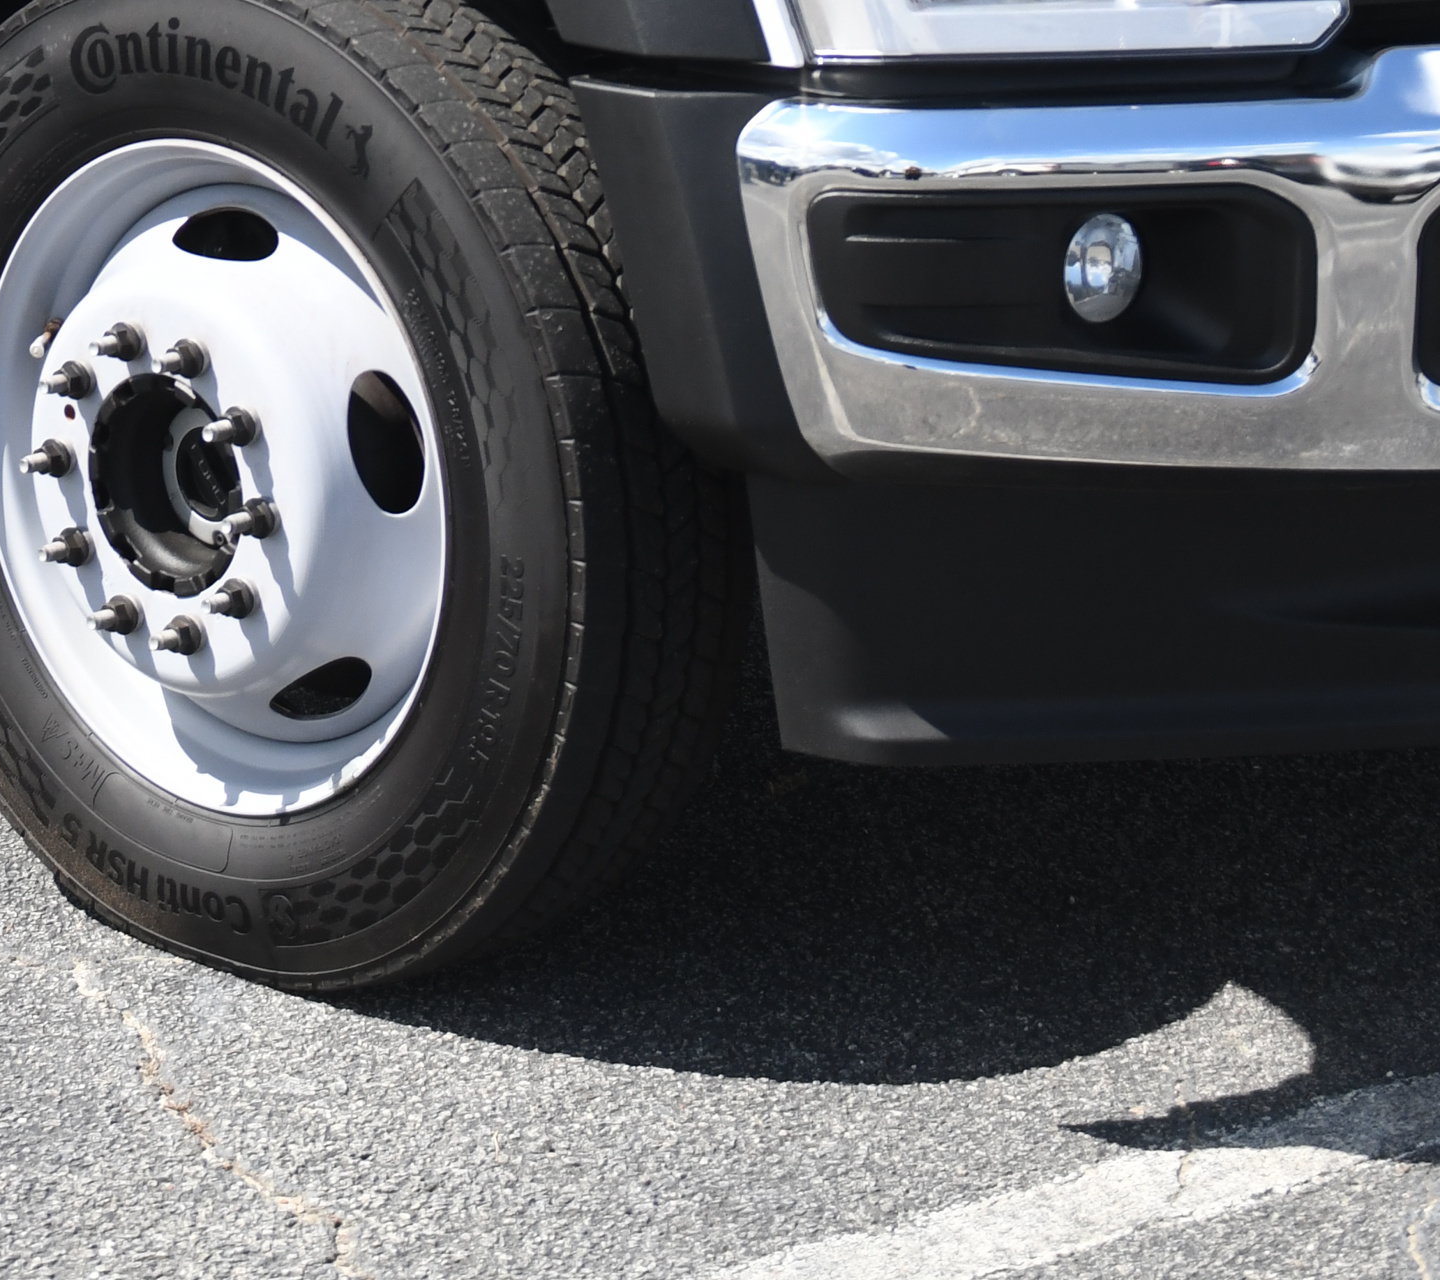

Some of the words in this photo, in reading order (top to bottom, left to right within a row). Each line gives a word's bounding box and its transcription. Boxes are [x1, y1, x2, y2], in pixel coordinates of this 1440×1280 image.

[69, 16, 345, 151] Continental
[84, 841, 150, 904] HSR
[156, 865, 253, 936] Conti
